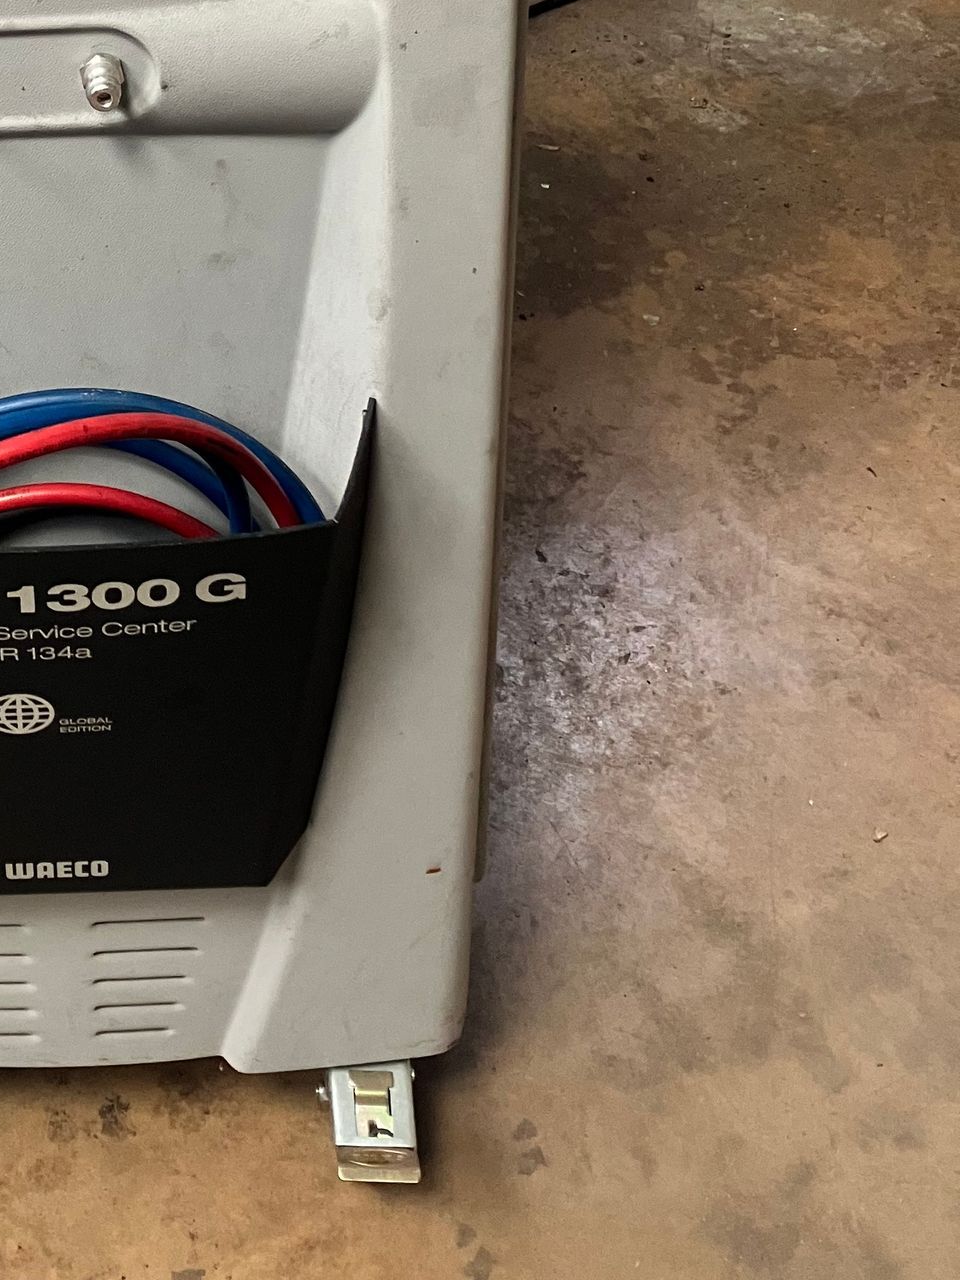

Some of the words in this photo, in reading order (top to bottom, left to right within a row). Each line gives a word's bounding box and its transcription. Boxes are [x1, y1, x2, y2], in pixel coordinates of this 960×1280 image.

[6, 578, 181, 614] 1300
[195, 572, 247, 603] G
[100, 618, 198, 637] Center
[0, 647, 19, 661] R
[26, 645, 93, 660] 134a
[59, 717, 113, 726] GLOBAL
[59, 725, 112, 733] EDITION
[5, 860, 110, 880] WAECO
